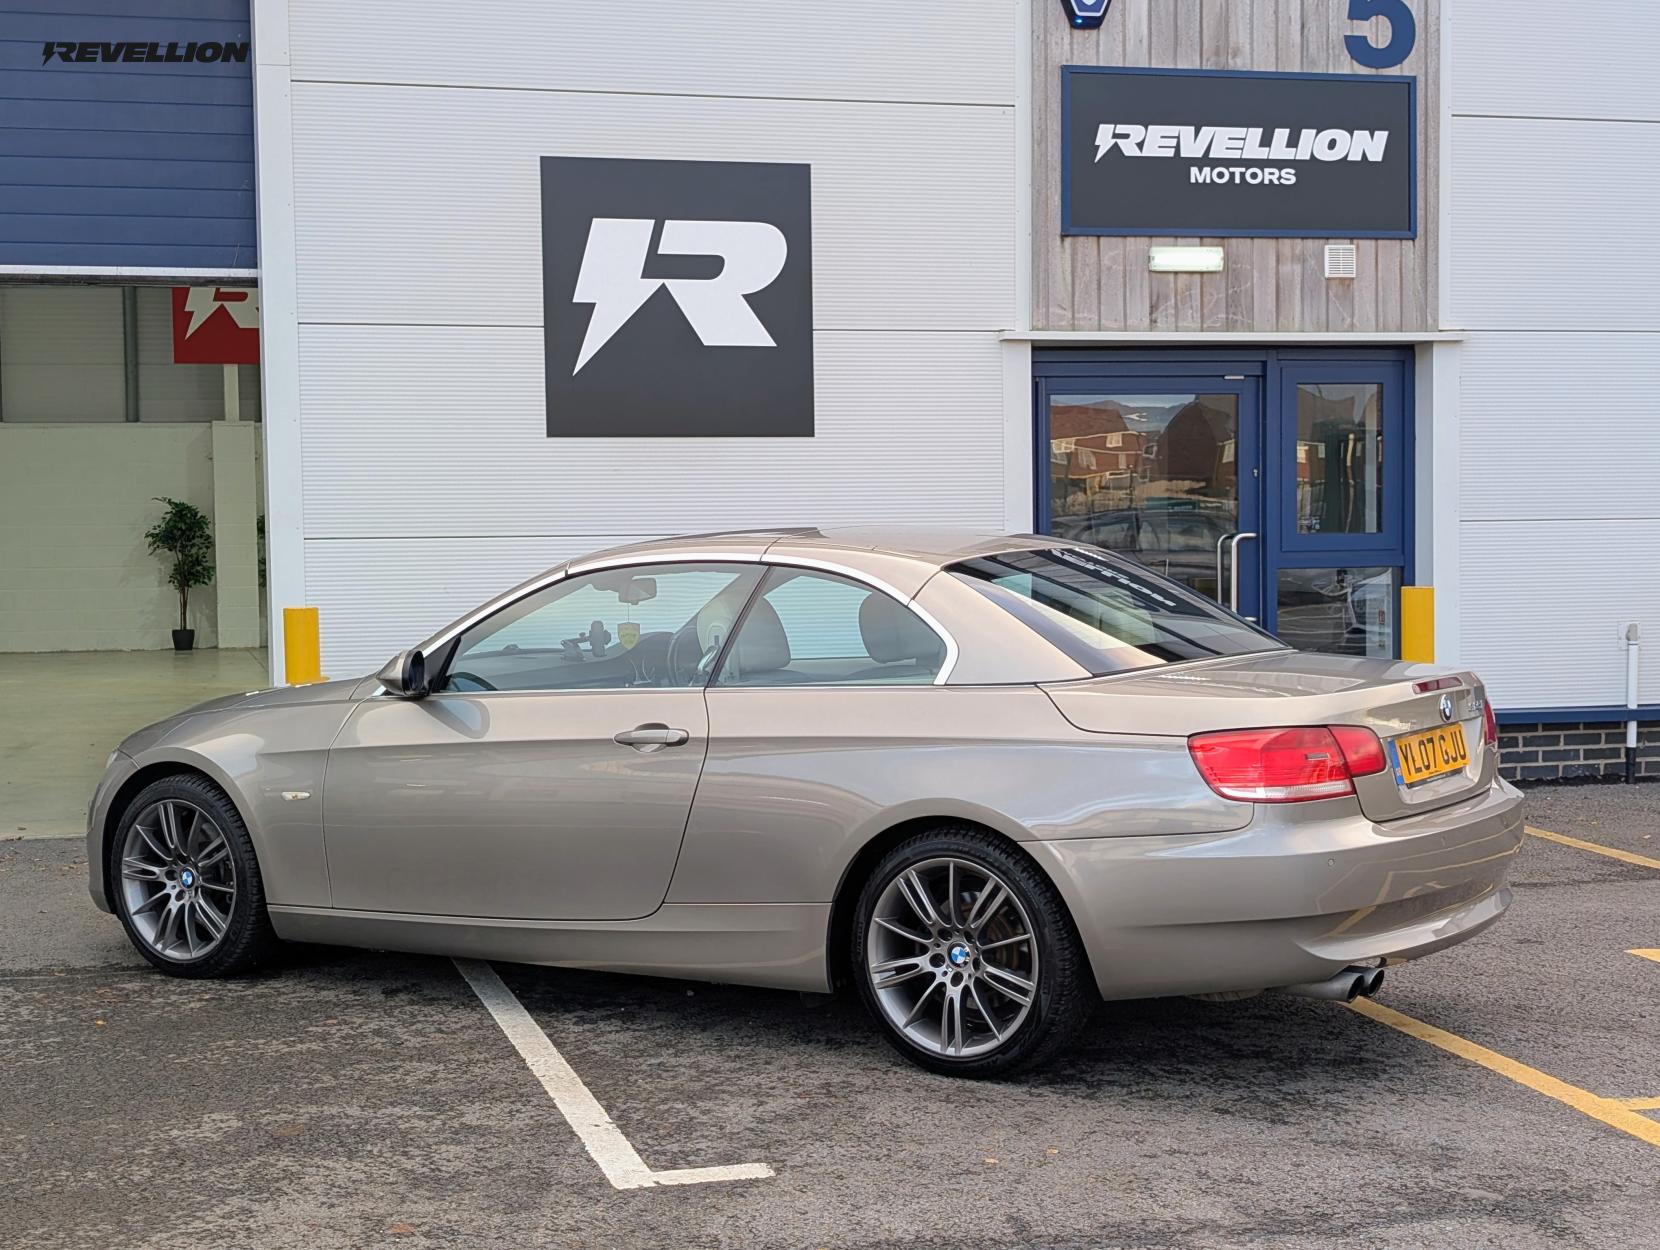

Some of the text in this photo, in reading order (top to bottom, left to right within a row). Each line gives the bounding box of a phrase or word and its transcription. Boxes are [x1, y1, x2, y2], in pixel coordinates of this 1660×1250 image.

[1344, 0, 1416, 69] 5
[1094, 123, 1389, 163] REVELLION
[1190, 166, 1297, 185] MOTORS
[572, 217, 788, 377] R
[1399, 729, 1467, 776] YL07 GJU
